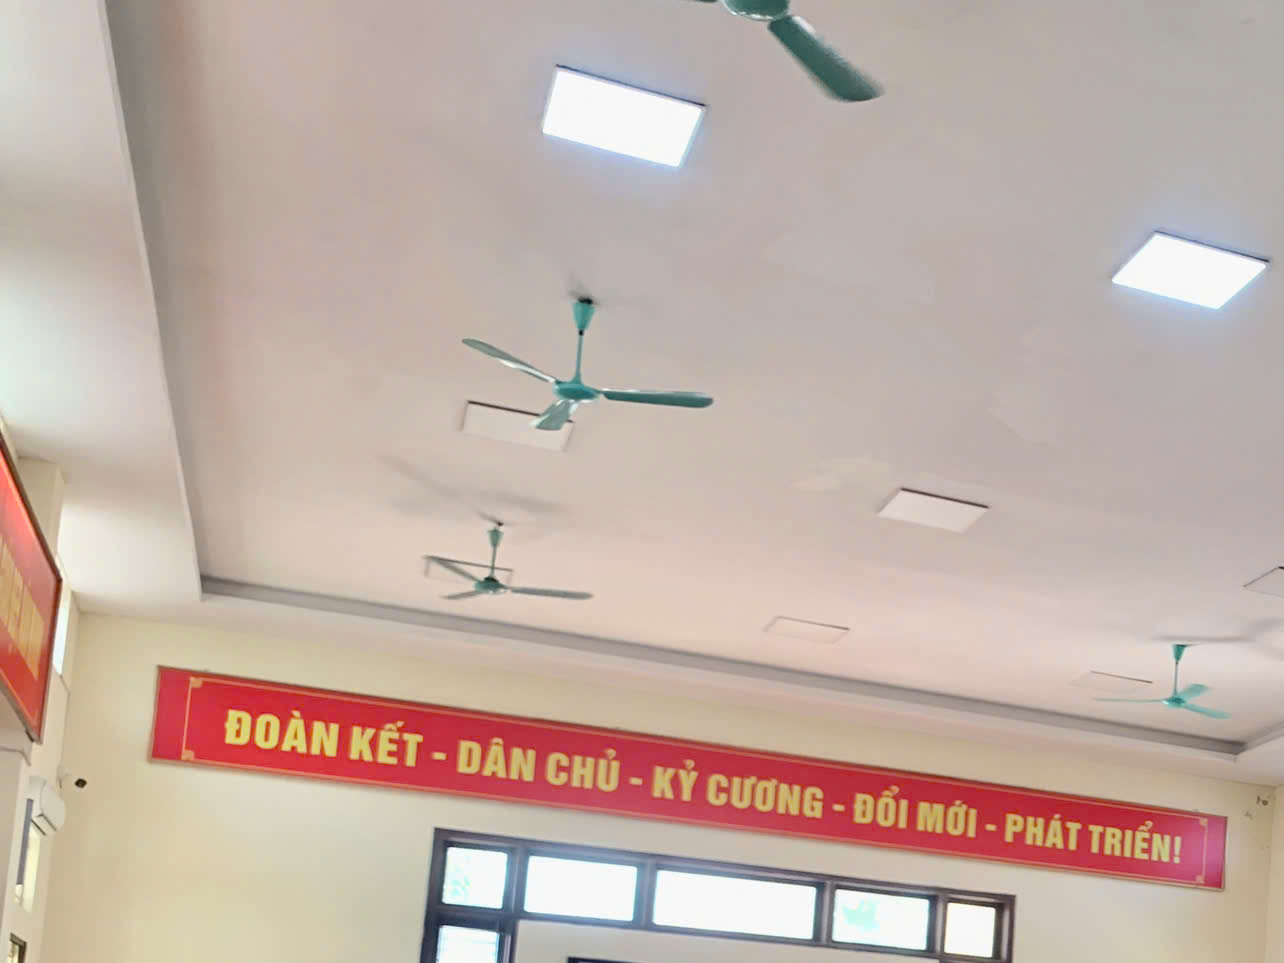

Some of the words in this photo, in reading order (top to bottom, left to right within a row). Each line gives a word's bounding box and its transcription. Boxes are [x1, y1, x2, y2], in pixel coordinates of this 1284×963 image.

[224, 707, 340, 760] ĐOÀN
[348, 720, 423, 767] KẾT
[457, 737, 535, 785] DÂN
[546, 748, 621, 793] CHỦ
[652, 759, 699, 802] KỶ
[706, 773, 825, 820] CƯƠNG
[853, 785, 908, 830] ĐỔI
[916, 799, 978, 840] MỚI
[1004, 813, 1083, 852] PHÁT
[1089, 820, 1183, 865] TRIỂN!
